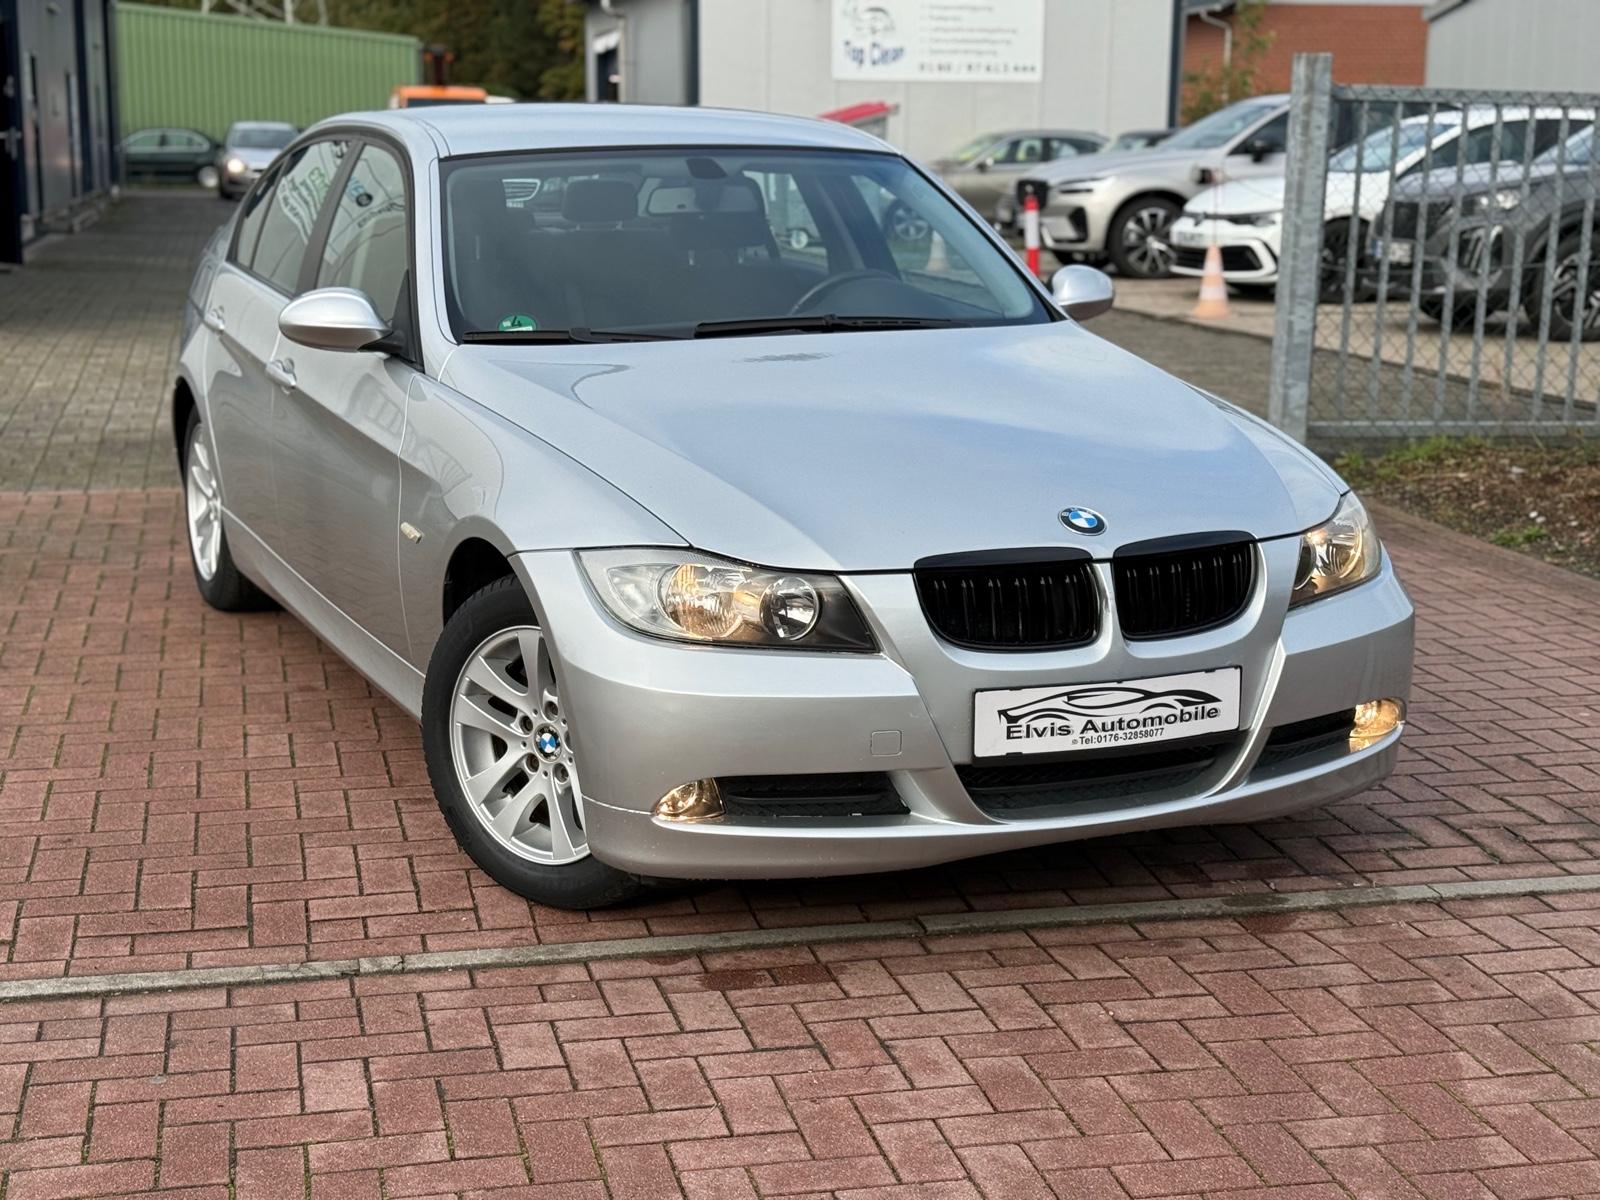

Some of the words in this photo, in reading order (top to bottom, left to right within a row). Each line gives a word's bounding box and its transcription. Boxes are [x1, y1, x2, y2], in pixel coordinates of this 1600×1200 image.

[1006, 722, 1072, 740] Elvis
[1080, 705, 1222, 735] Automobile
[1079, 727, 1165, 745] Tel:0176-32858077
